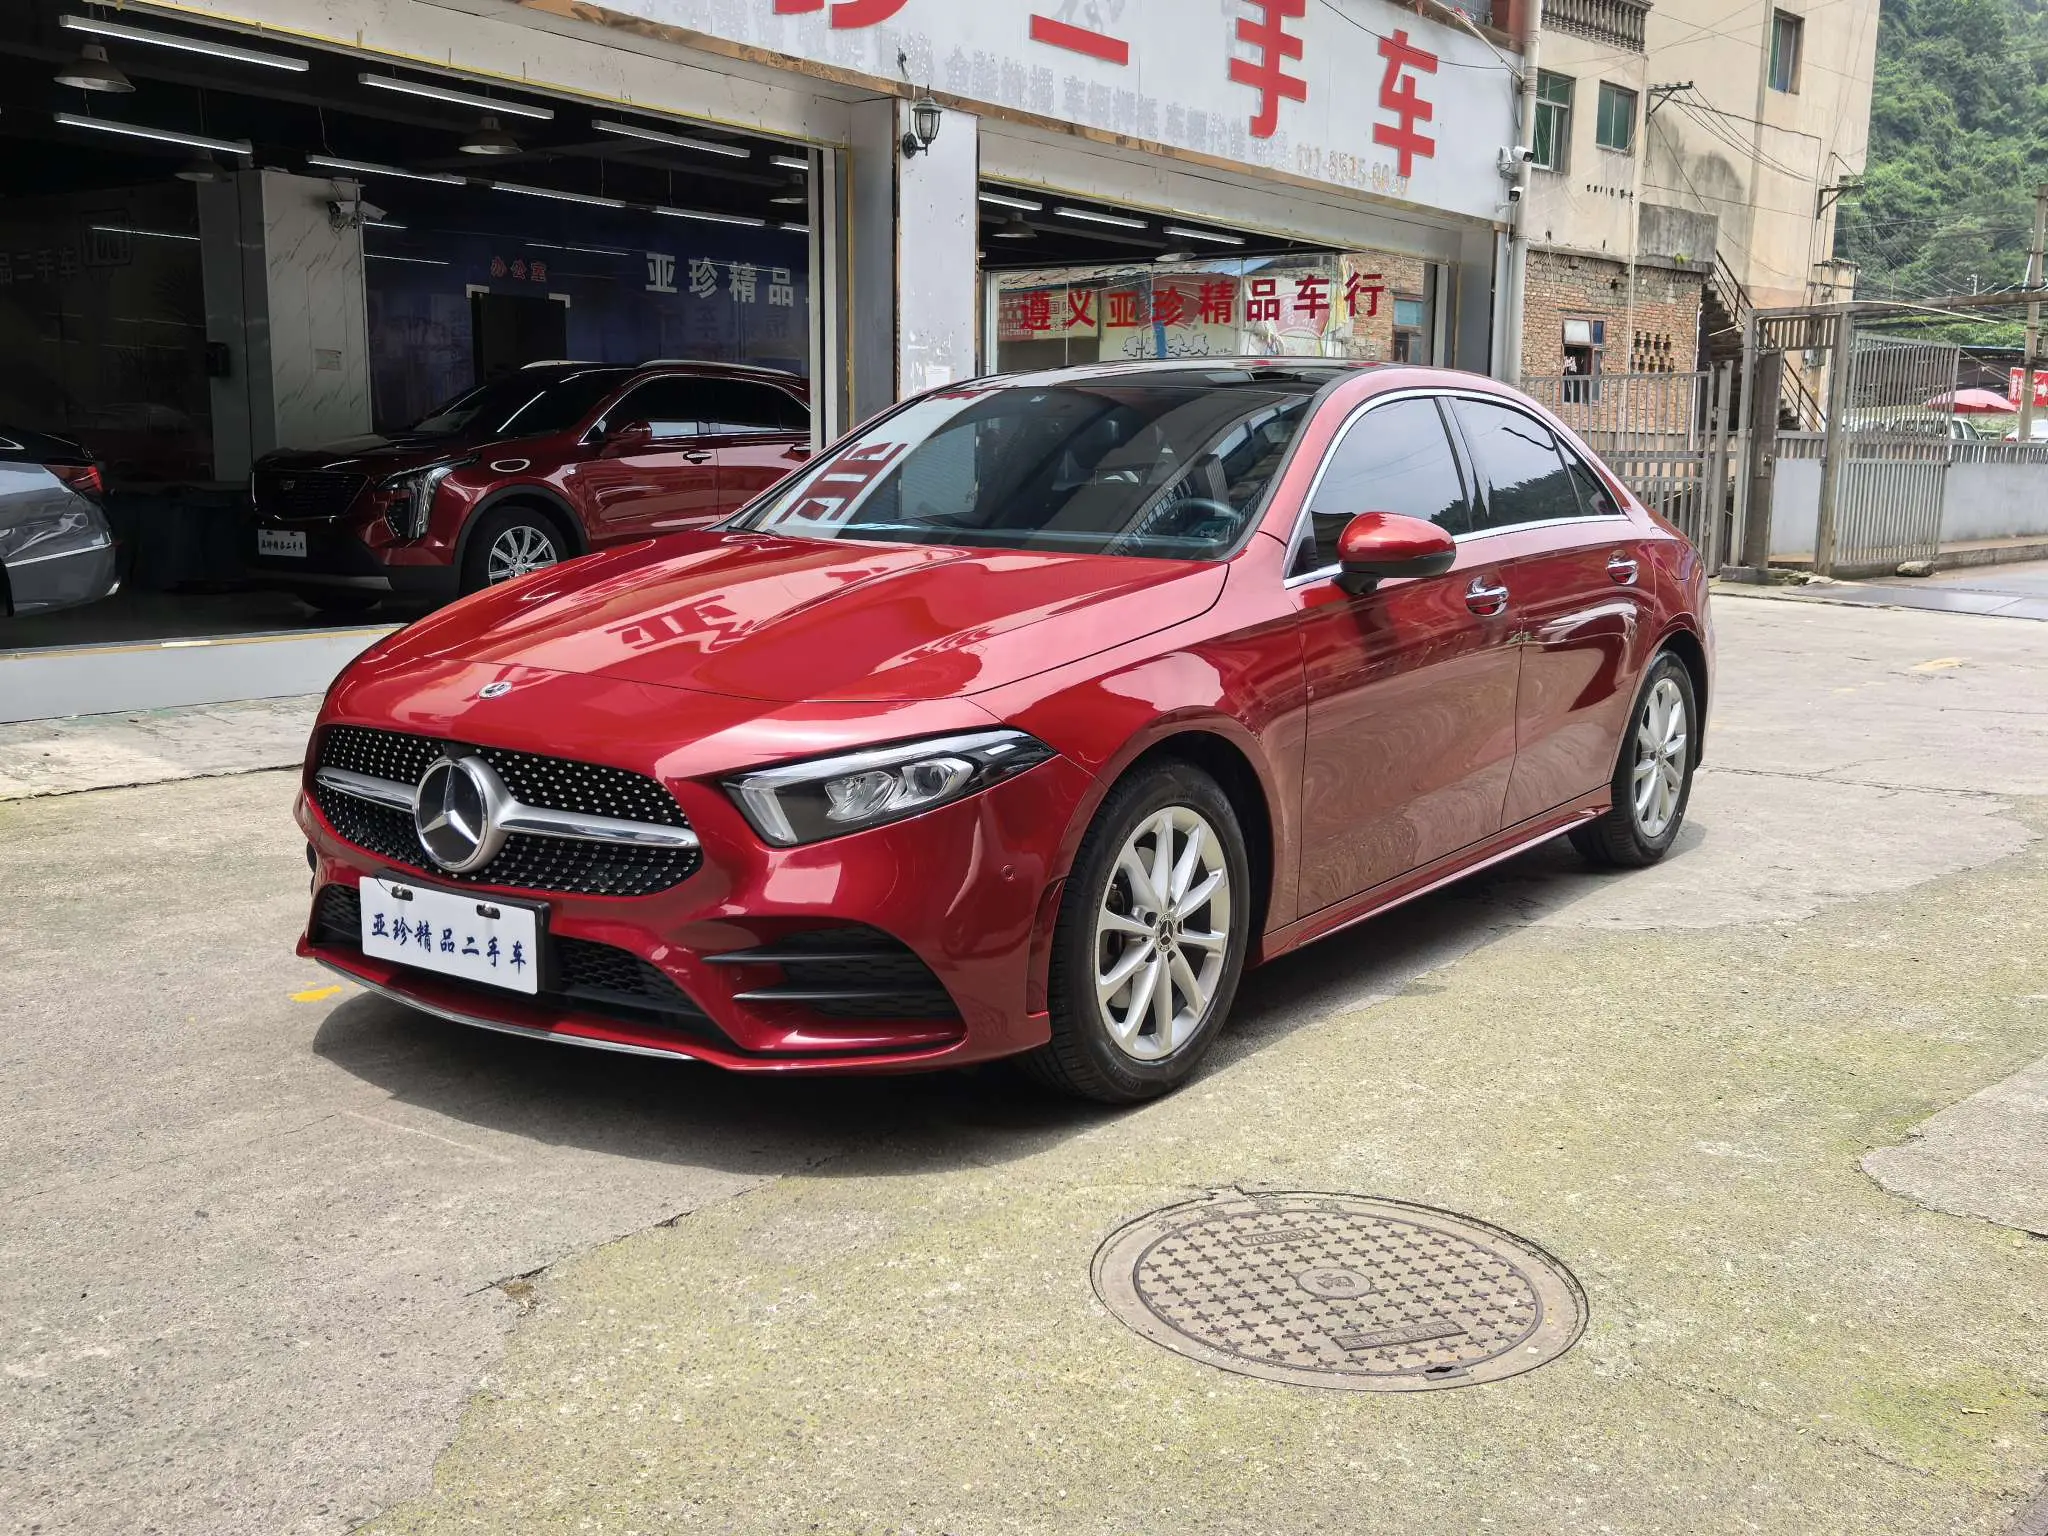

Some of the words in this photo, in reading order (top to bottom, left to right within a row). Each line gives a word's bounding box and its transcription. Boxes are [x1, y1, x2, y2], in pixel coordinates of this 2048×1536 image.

[490, 255, 547, 283] 办公室
[1021, 271, 1385, 331] 遵义亚珍精品车行
[371, 912, 527, 975] 亚珍精品二手车
